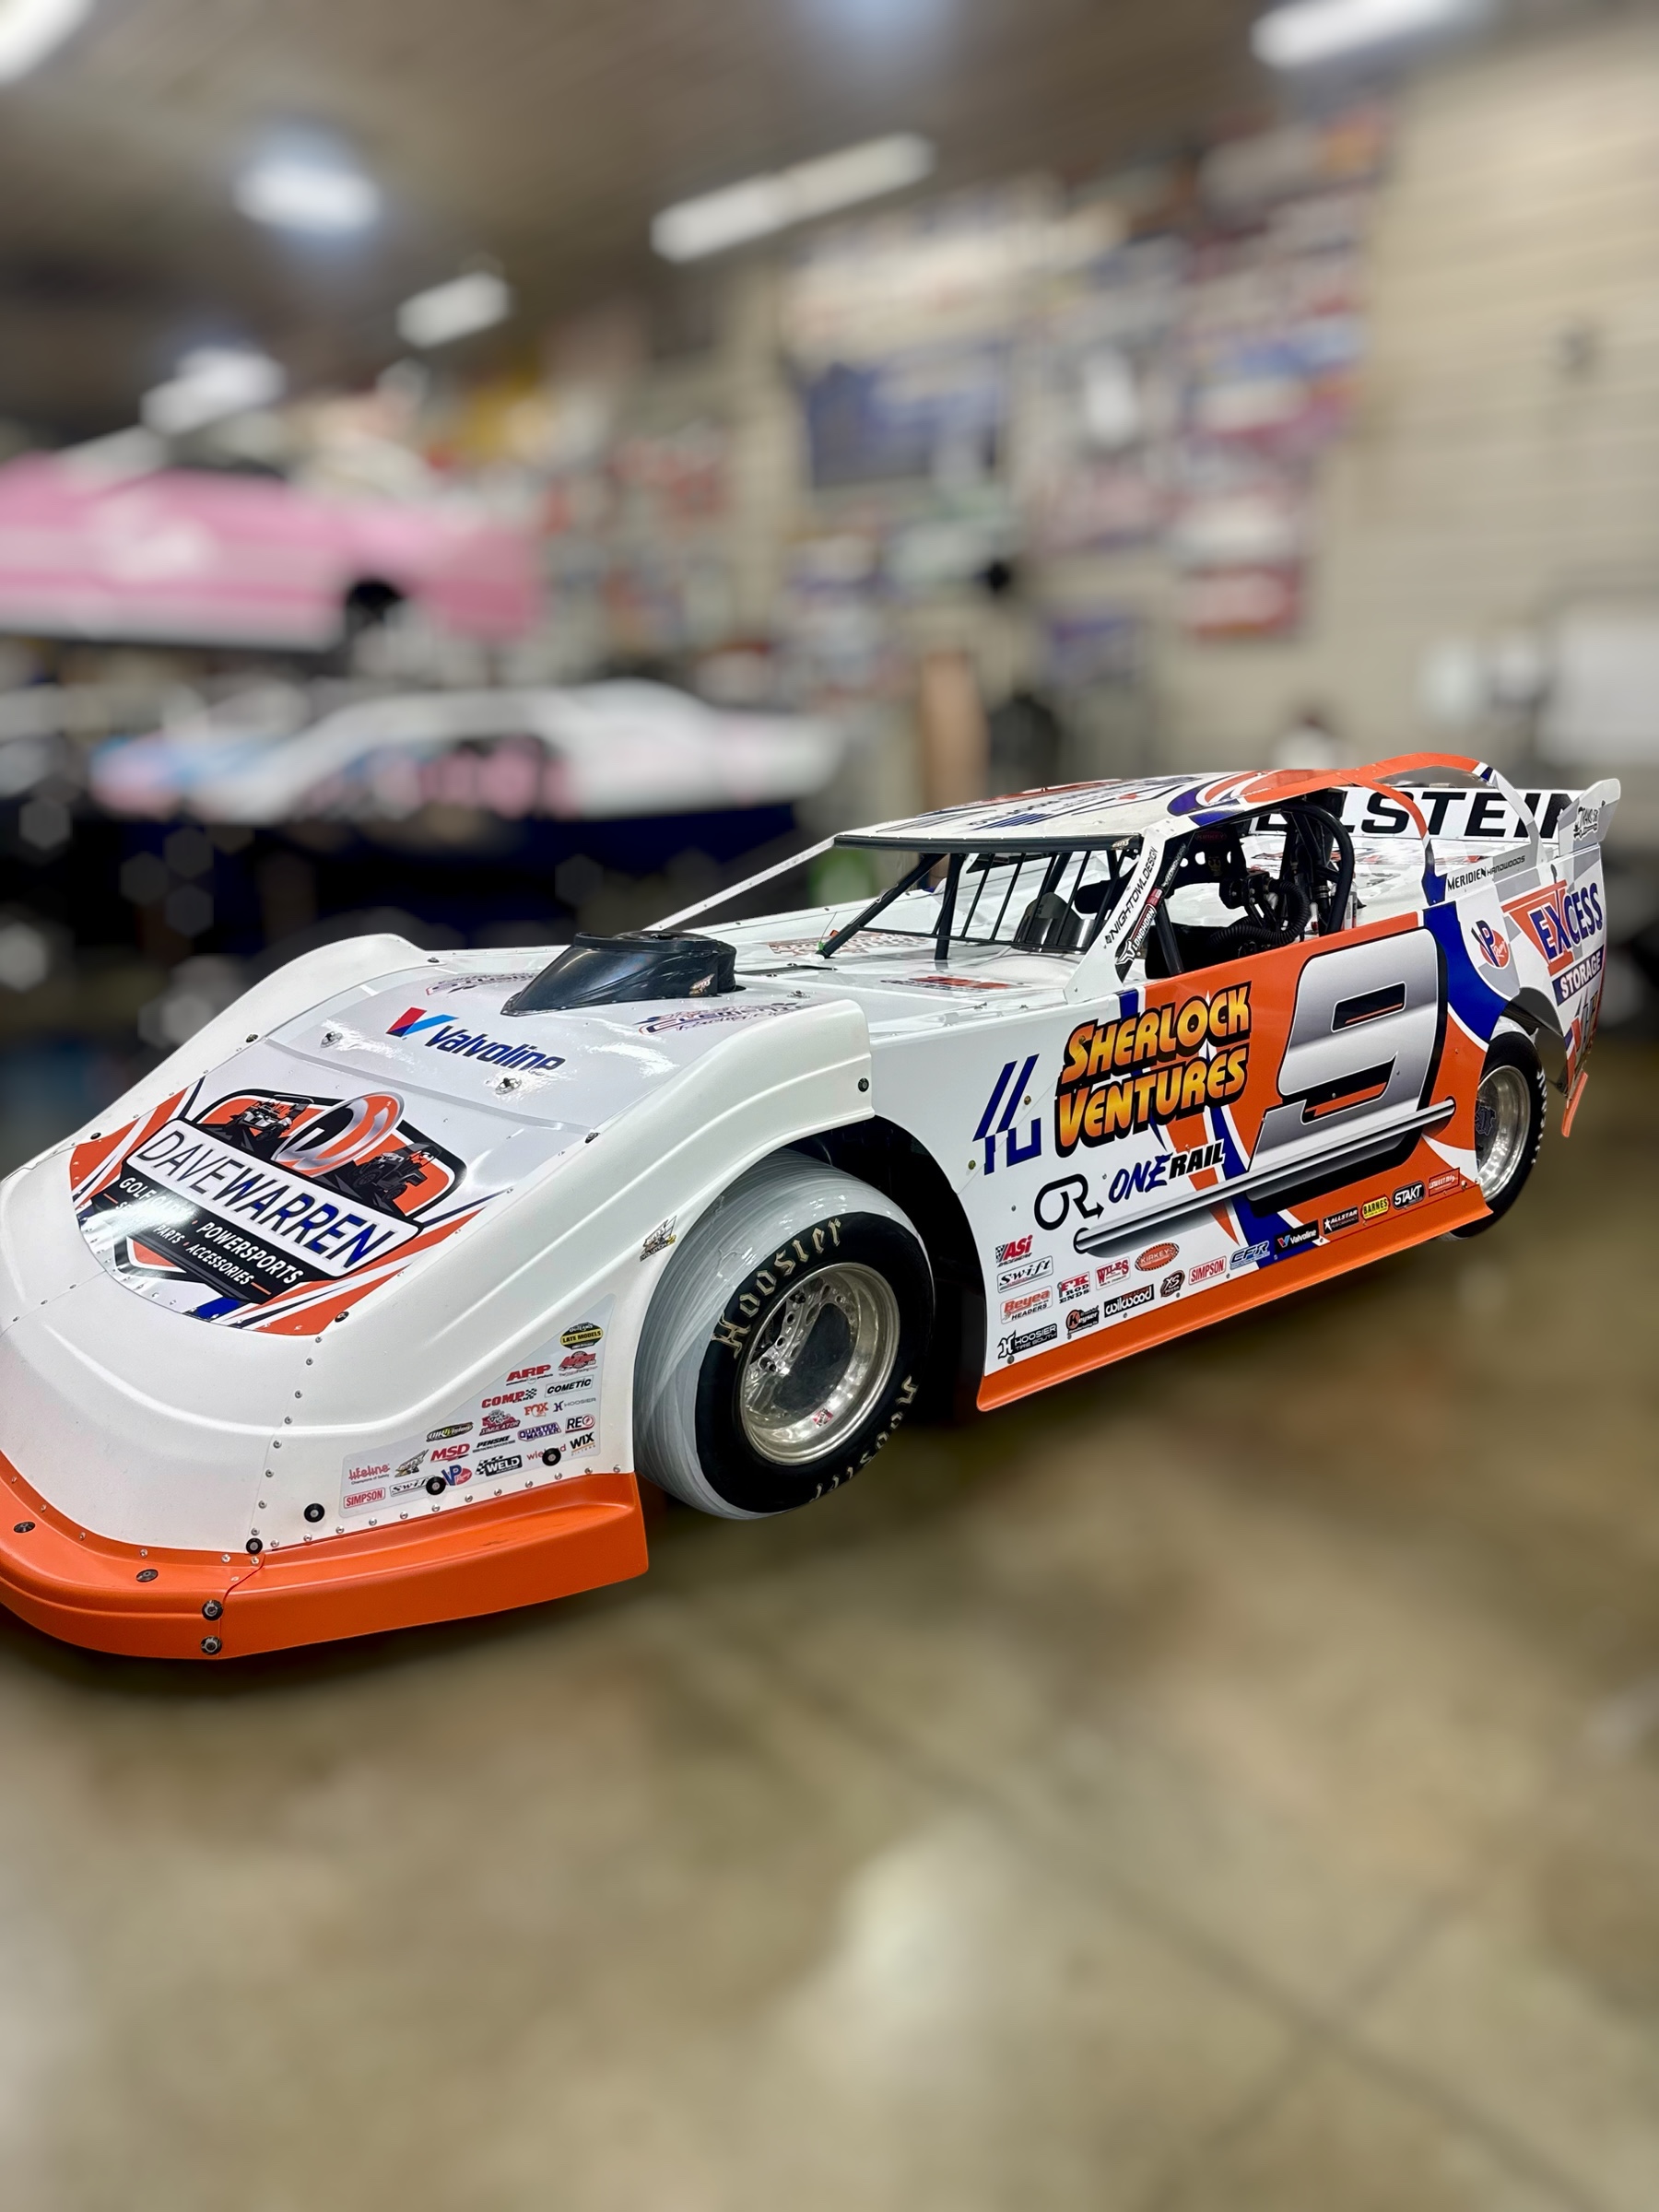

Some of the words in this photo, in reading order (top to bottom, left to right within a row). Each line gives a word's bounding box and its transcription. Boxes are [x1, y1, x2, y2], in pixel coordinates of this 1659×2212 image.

[1447, 866, 1487, 891] MERIDIEN
[1133, 907, 1156, 950] LONGHORN
[1529, 882, 1603, 960] EXCESS
[1559, 949, 1602, 999] STORAGE
[1059, 982, 1251, 1086] SHERLOCK
[424, 1025, 566, 1071] Valvoline
[1248, 926, 1443, 1172] 9
[1057, 1045, 1249, 1150] VENTURES
[1394, 1184, 1423, 1206] STAKT
[1363, 1198, 1388, 1215] BARNES
[1330, 1209, 1358, 1224] ALLSTAR
[119, 1176, 157, 1201] GOLF
[195, 1221, 304, 1284] POWERSPORTS
[1290, 1230, 1317, 1245] Valvoline
[153, 1224, 186, 1244] PARTS
[185, 1244, 254, 1285] ACCESSORIES
[1096, 1259, 1130, 1284] WILES
[1190, 1259, 1225, 1282] SIMPSON
[1061, 1274, 1088, 1291] FK
[1065, 1283, 1089, 1296] ROD
[1004, 1289, 1051, 1312] Beyea
[1059, 1289, 1090, 1304] ENDS
[1105, 1285, 1152, 1315] wilwood
[1011, 1302, 1048, 1321] HEADERS
[577, 1331, 602, 1340] MODELS
[1014, 1324, 1057, 1346] HOOSIER
[506, 1364, 552, 1382] ARP
[547, 1378, 592, 1394] COMETIC
[481, 1390, 526, 1408] COMP
[564, 1397, 596, 1407] HOOSIER
[524, 1402, 549, 1417] FOX
[518, 1421, 559, 1438] QUARTER
[526, 1428, 561, 1440] MASTER
[477, 1434, 511, 1449] PENSKE
[570, 1431, 594, 1450] WIX
[430, 1442, 471, 1461] MSD
[526, 1443, 567, 1461] wied
[486, 1457, 521, 1472] WELD
[391, 1477, 429, 1493] Swif
[441, 1465, 462, 1487] VP
[346, 1488, 383, 1507] SIMPSON
